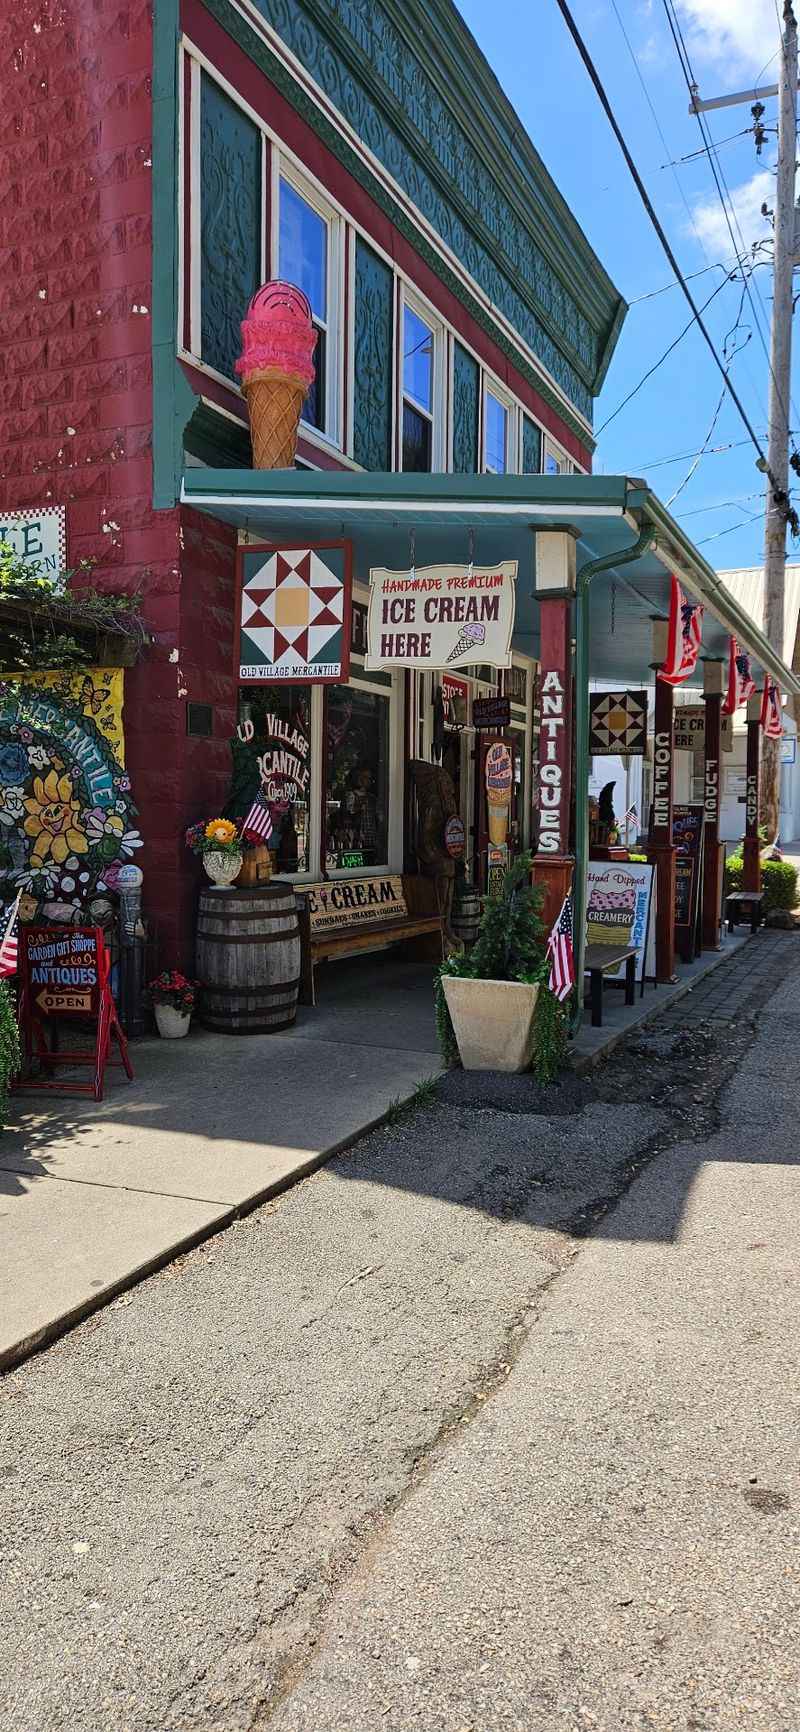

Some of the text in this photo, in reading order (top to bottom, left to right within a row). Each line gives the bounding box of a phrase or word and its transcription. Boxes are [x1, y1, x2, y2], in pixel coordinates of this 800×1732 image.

[381, 574, 503, 593] HANDMADE PREMIUM
[382, 595, 500, 625] ICE CREAM
[380, 633, 432, 657] HERE
[241, 665, 339, 678] OLD VILLAGE MERCANTILE
[236, 713, 309, 759] LD VILLAGE
[537, 671, 564, 854] ANTIQUES
[654, 732, 671, 827] COFFEE
[704, 759, 718, 823] FUDGE
[747, 776, 757, 825] CANDY
[587, 872, 645, 887] Hand Dipped
[331, 881, 397, 909] CREAM
[588, 911, 633, 924] CREAMERY
[28, 938, 96, 960] GARDEN GIFT SHOPPE
[32, 968, 96, 984] ANTIQUES
[45, 996, 85, 1008] OPEN
